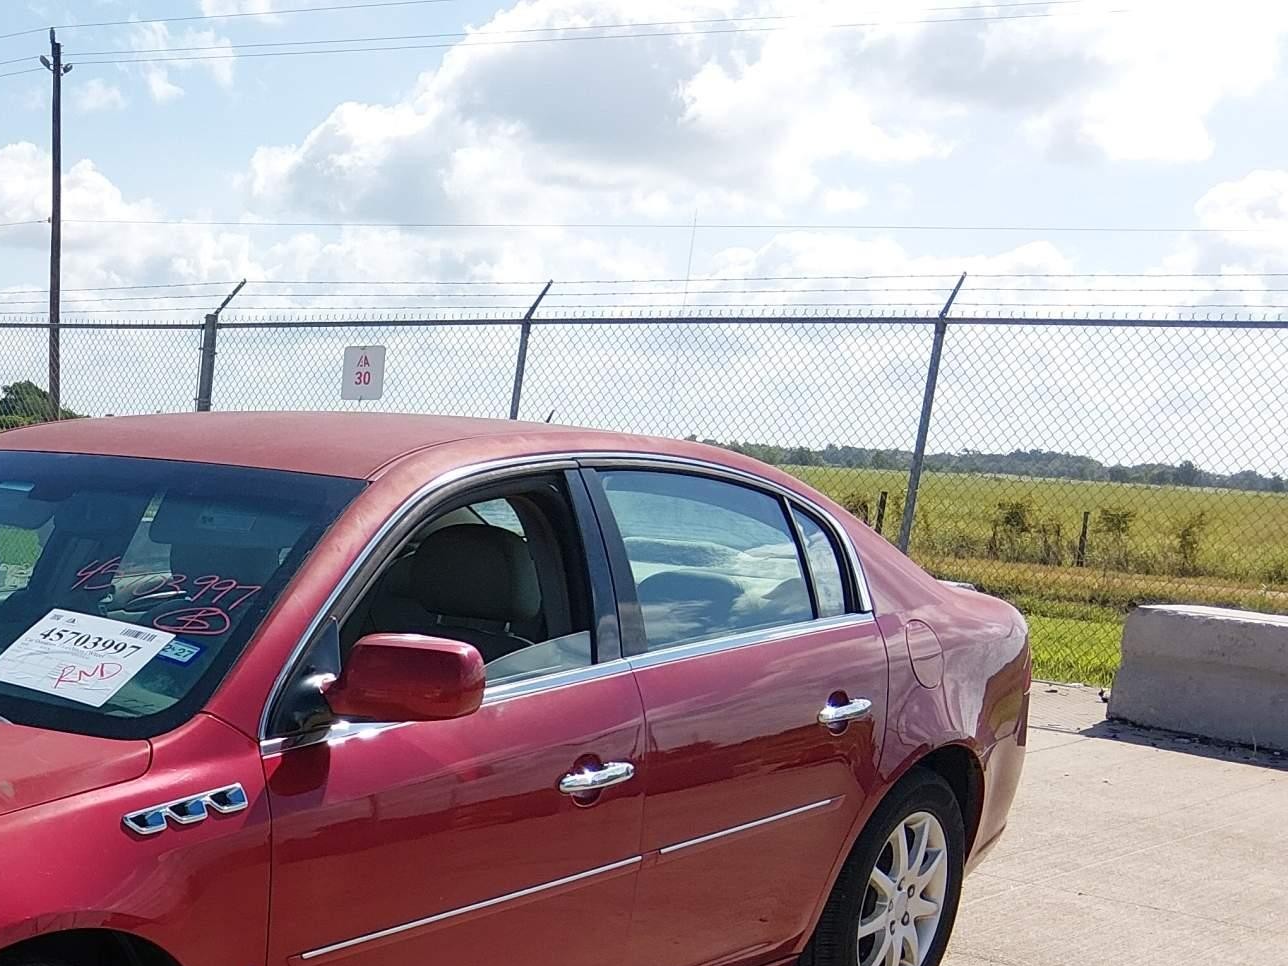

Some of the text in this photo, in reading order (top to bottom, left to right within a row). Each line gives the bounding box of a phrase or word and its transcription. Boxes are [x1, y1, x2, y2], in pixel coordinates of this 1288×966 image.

[354, 370, 371, 385] 30
[40, 627, 143, 659] 45703997
[54, 662, 123, 689] RND
